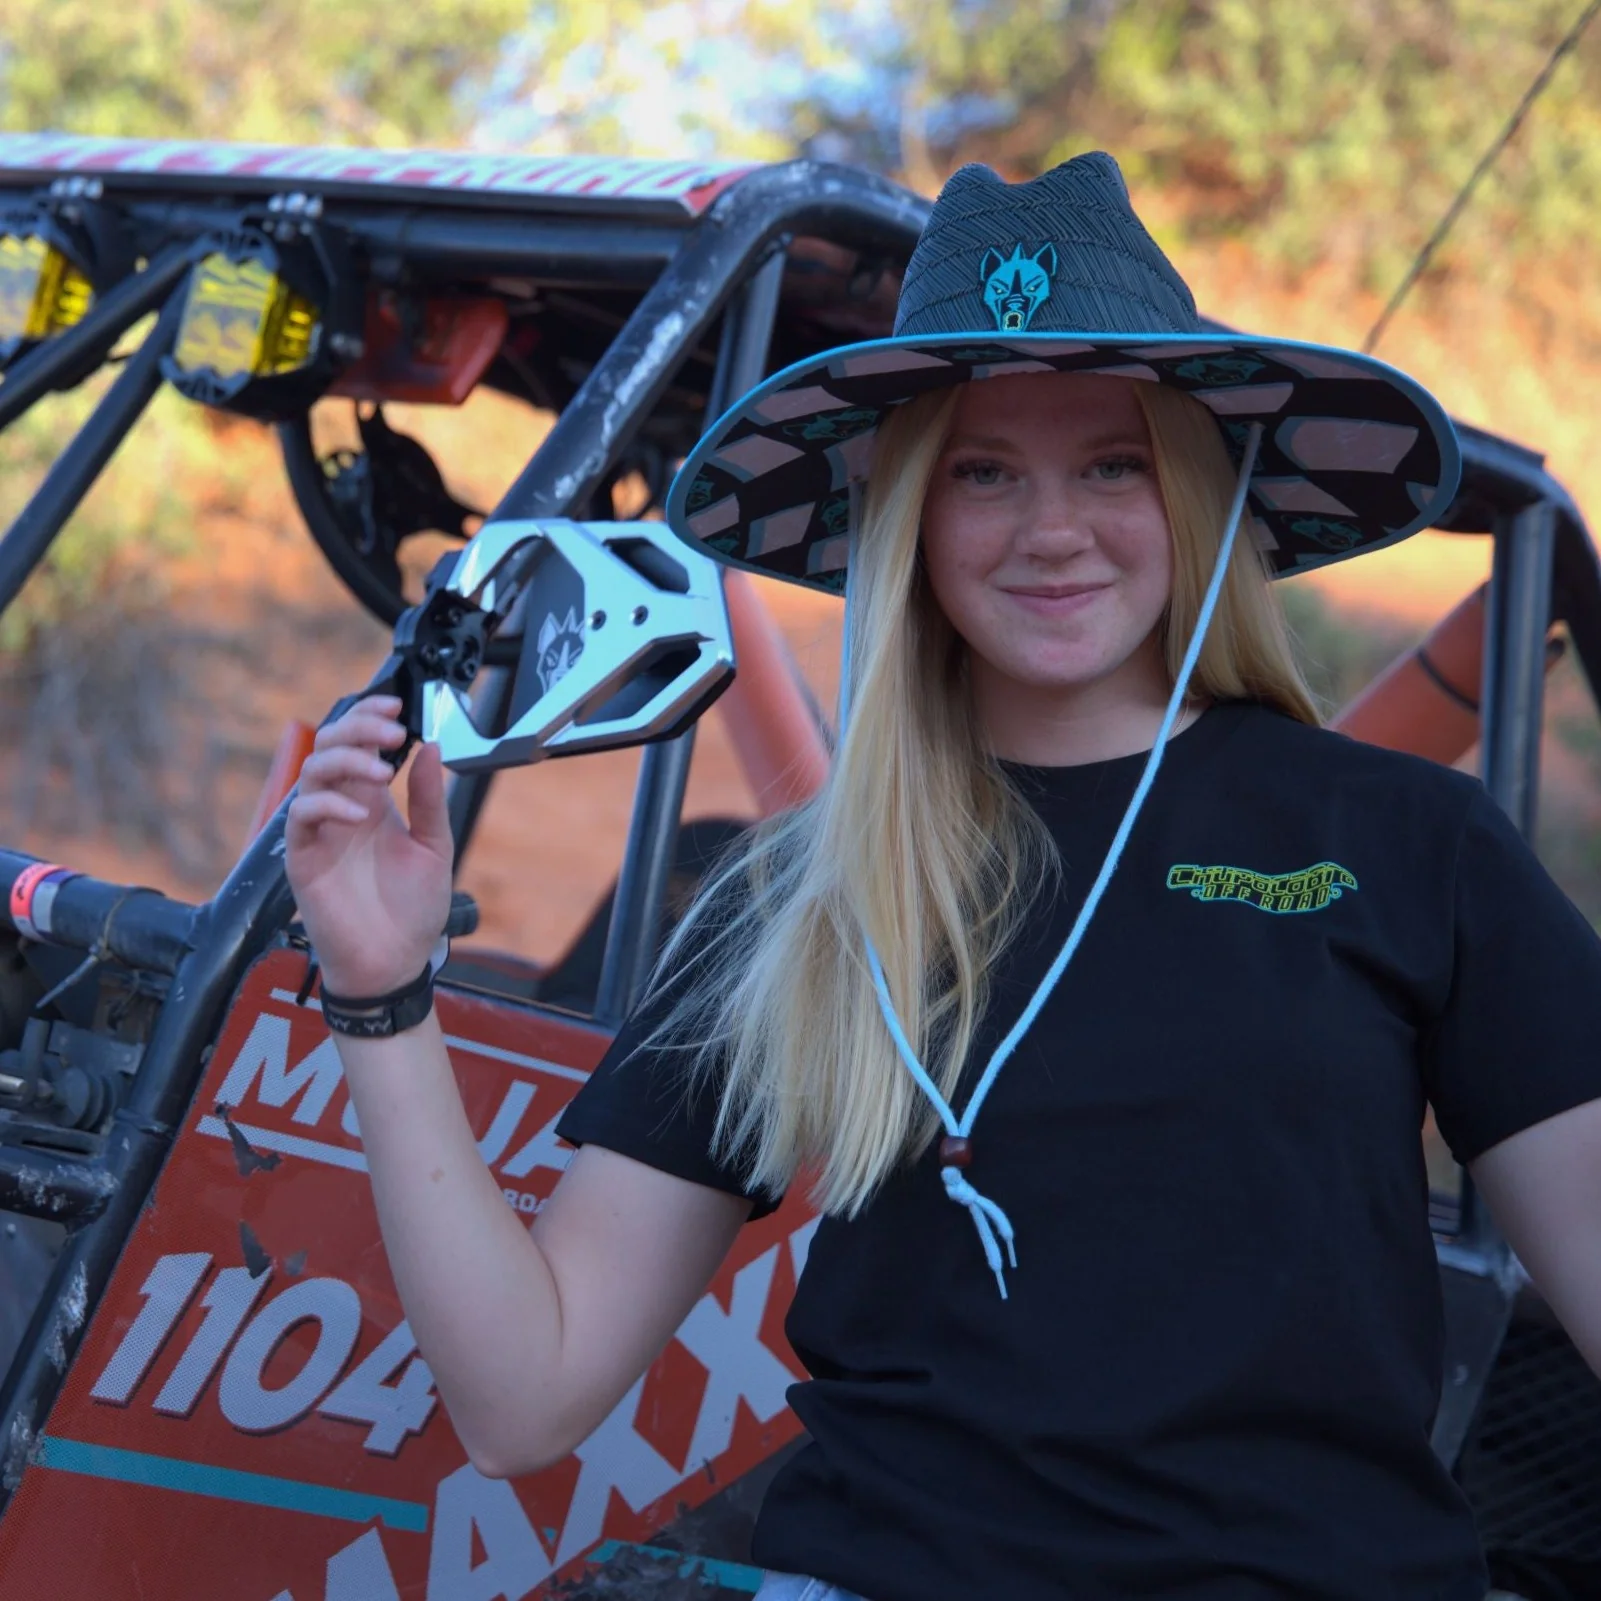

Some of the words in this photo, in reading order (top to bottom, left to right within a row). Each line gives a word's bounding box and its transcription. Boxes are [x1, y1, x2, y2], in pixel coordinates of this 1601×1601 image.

[1202, 883, 1252, 901] OFF
[1260, 884, 1331, 911] ROAD
[503, 1188, 549, 1214] RO
[89, 1252, 437, 1459] 1104
